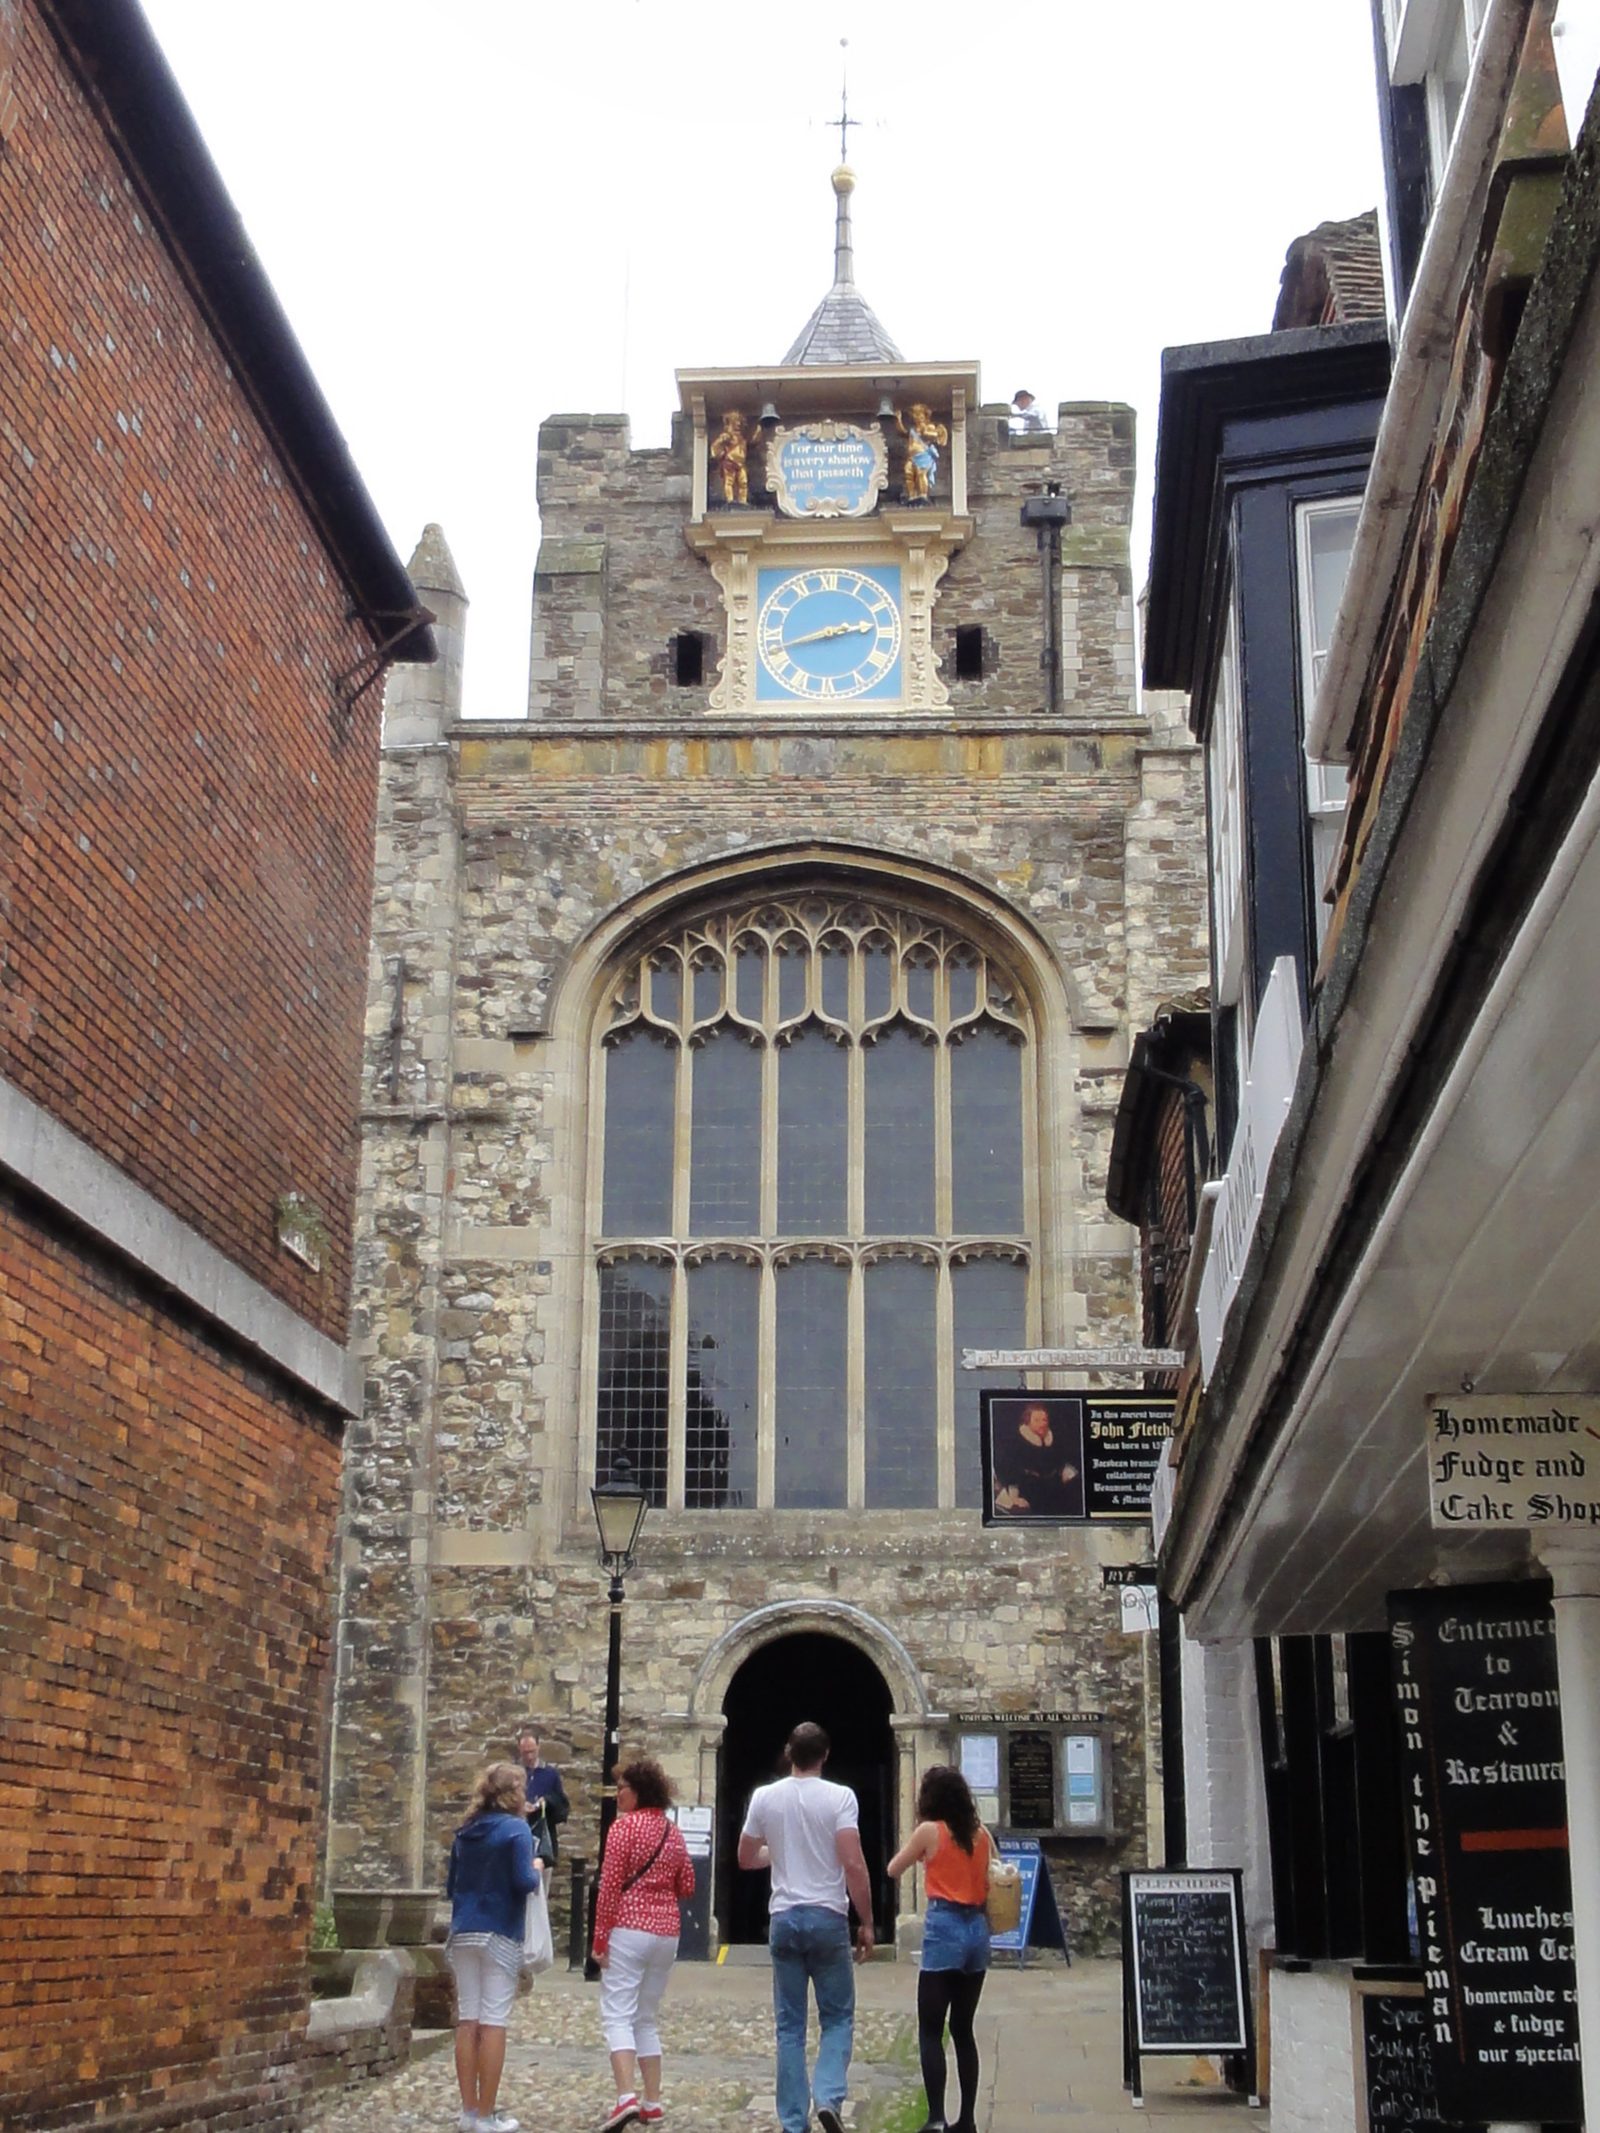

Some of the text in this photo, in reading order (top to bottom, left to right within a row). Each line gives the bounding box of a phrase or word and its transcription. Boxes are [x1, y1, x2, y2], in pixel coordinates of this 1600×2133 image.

[791, 443, 863, 454] For our time
[800, 457, 825, 468] very
[828, 454, 870, 465] shadow
[791, 467, 864, 480] that passeth
[1090, 1421, 1125, 1439] John
[1432, 1409, 1581, 1441] Homemade
[1121, 1442, 1140, 1450] born
[1141, 1442, 1150, 1450] in
[1436, 1450, 1585, 1484] Fudge and
[1112, 1495, 1120, 1504] &
[1440, 1494, 1600, 1524] Cake Shop
[1108, 1571, 1136, 1582] RYE
[1485, 1653, 1511, 1675] to
[995, 1713, 1030, 1721] WELCOME
[1498, 1720, 1519, 1746] &
[1021, 1841, 1038, 1850] OPEN
[1478, 1906, 1575, 1931] Lunches
[1460, 1940, 1529, 1963] Cream
[1464, 1986, 1555, 2006] homemade
[1493, 2014, 1565, 2037] & fudge
[1479, 2047, 1510, 2063] our
